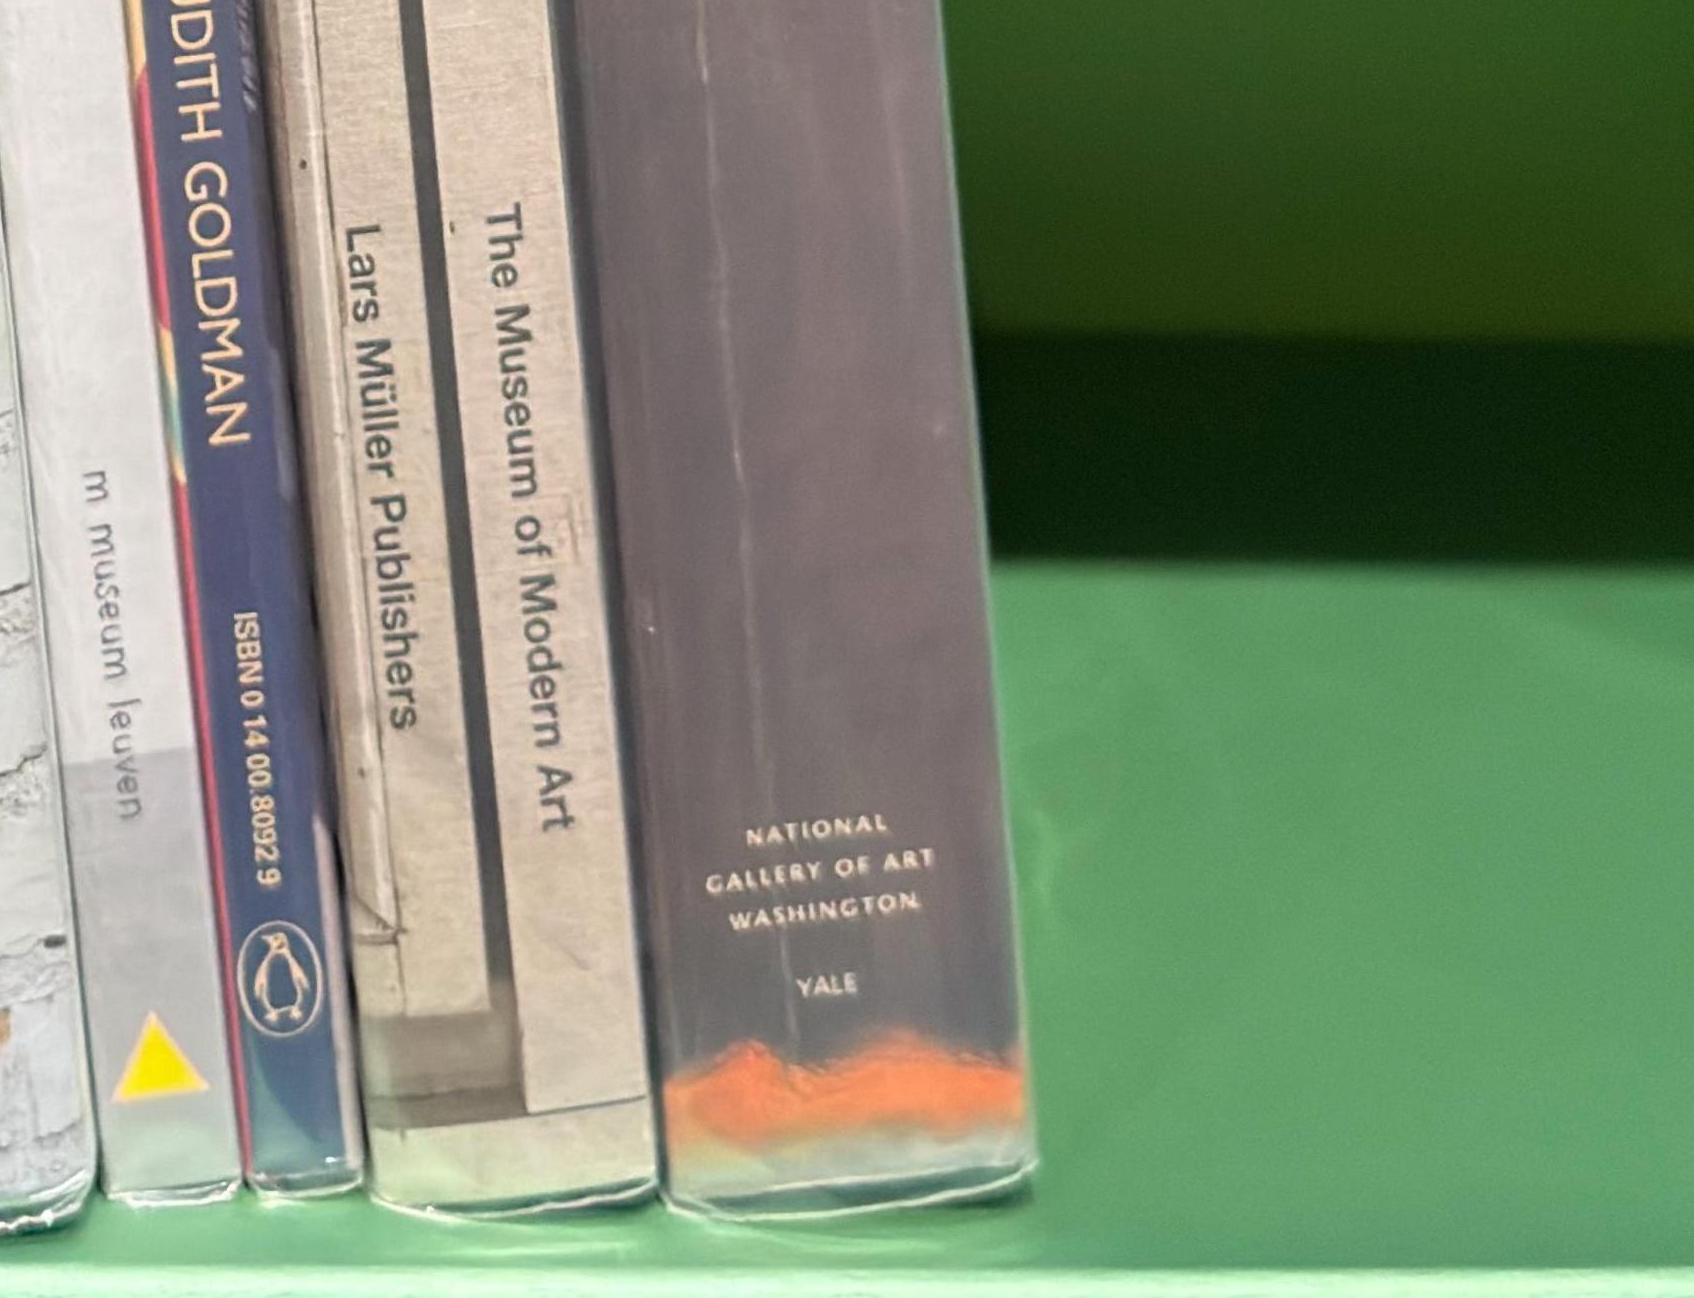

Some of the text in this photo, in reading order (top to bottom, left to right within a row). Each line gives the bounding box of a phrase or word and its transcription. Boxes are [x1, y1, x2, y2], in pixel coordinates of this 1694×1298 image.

[184, 162, 251, 447] GOLDMAN
[345, 223, 420, 731] Lars Müller Publishers
[487, 202, 575, 832] The Museum of Modern Art
[83, 470, 143, 820] m museum leuven
[234, 611, 263, 685] ISBN
[240, 690, 265, 707] 0
[243, 715, 269, 747] 14
[746, 814, 888, 847] NATIONAL
[256, 868, 282, 888] 9
[705, 849, 934, 893] GALLERY OF ART
[729, 892, 920, 931] WASHINGTON
[797, 971, 858, 998] YALE
